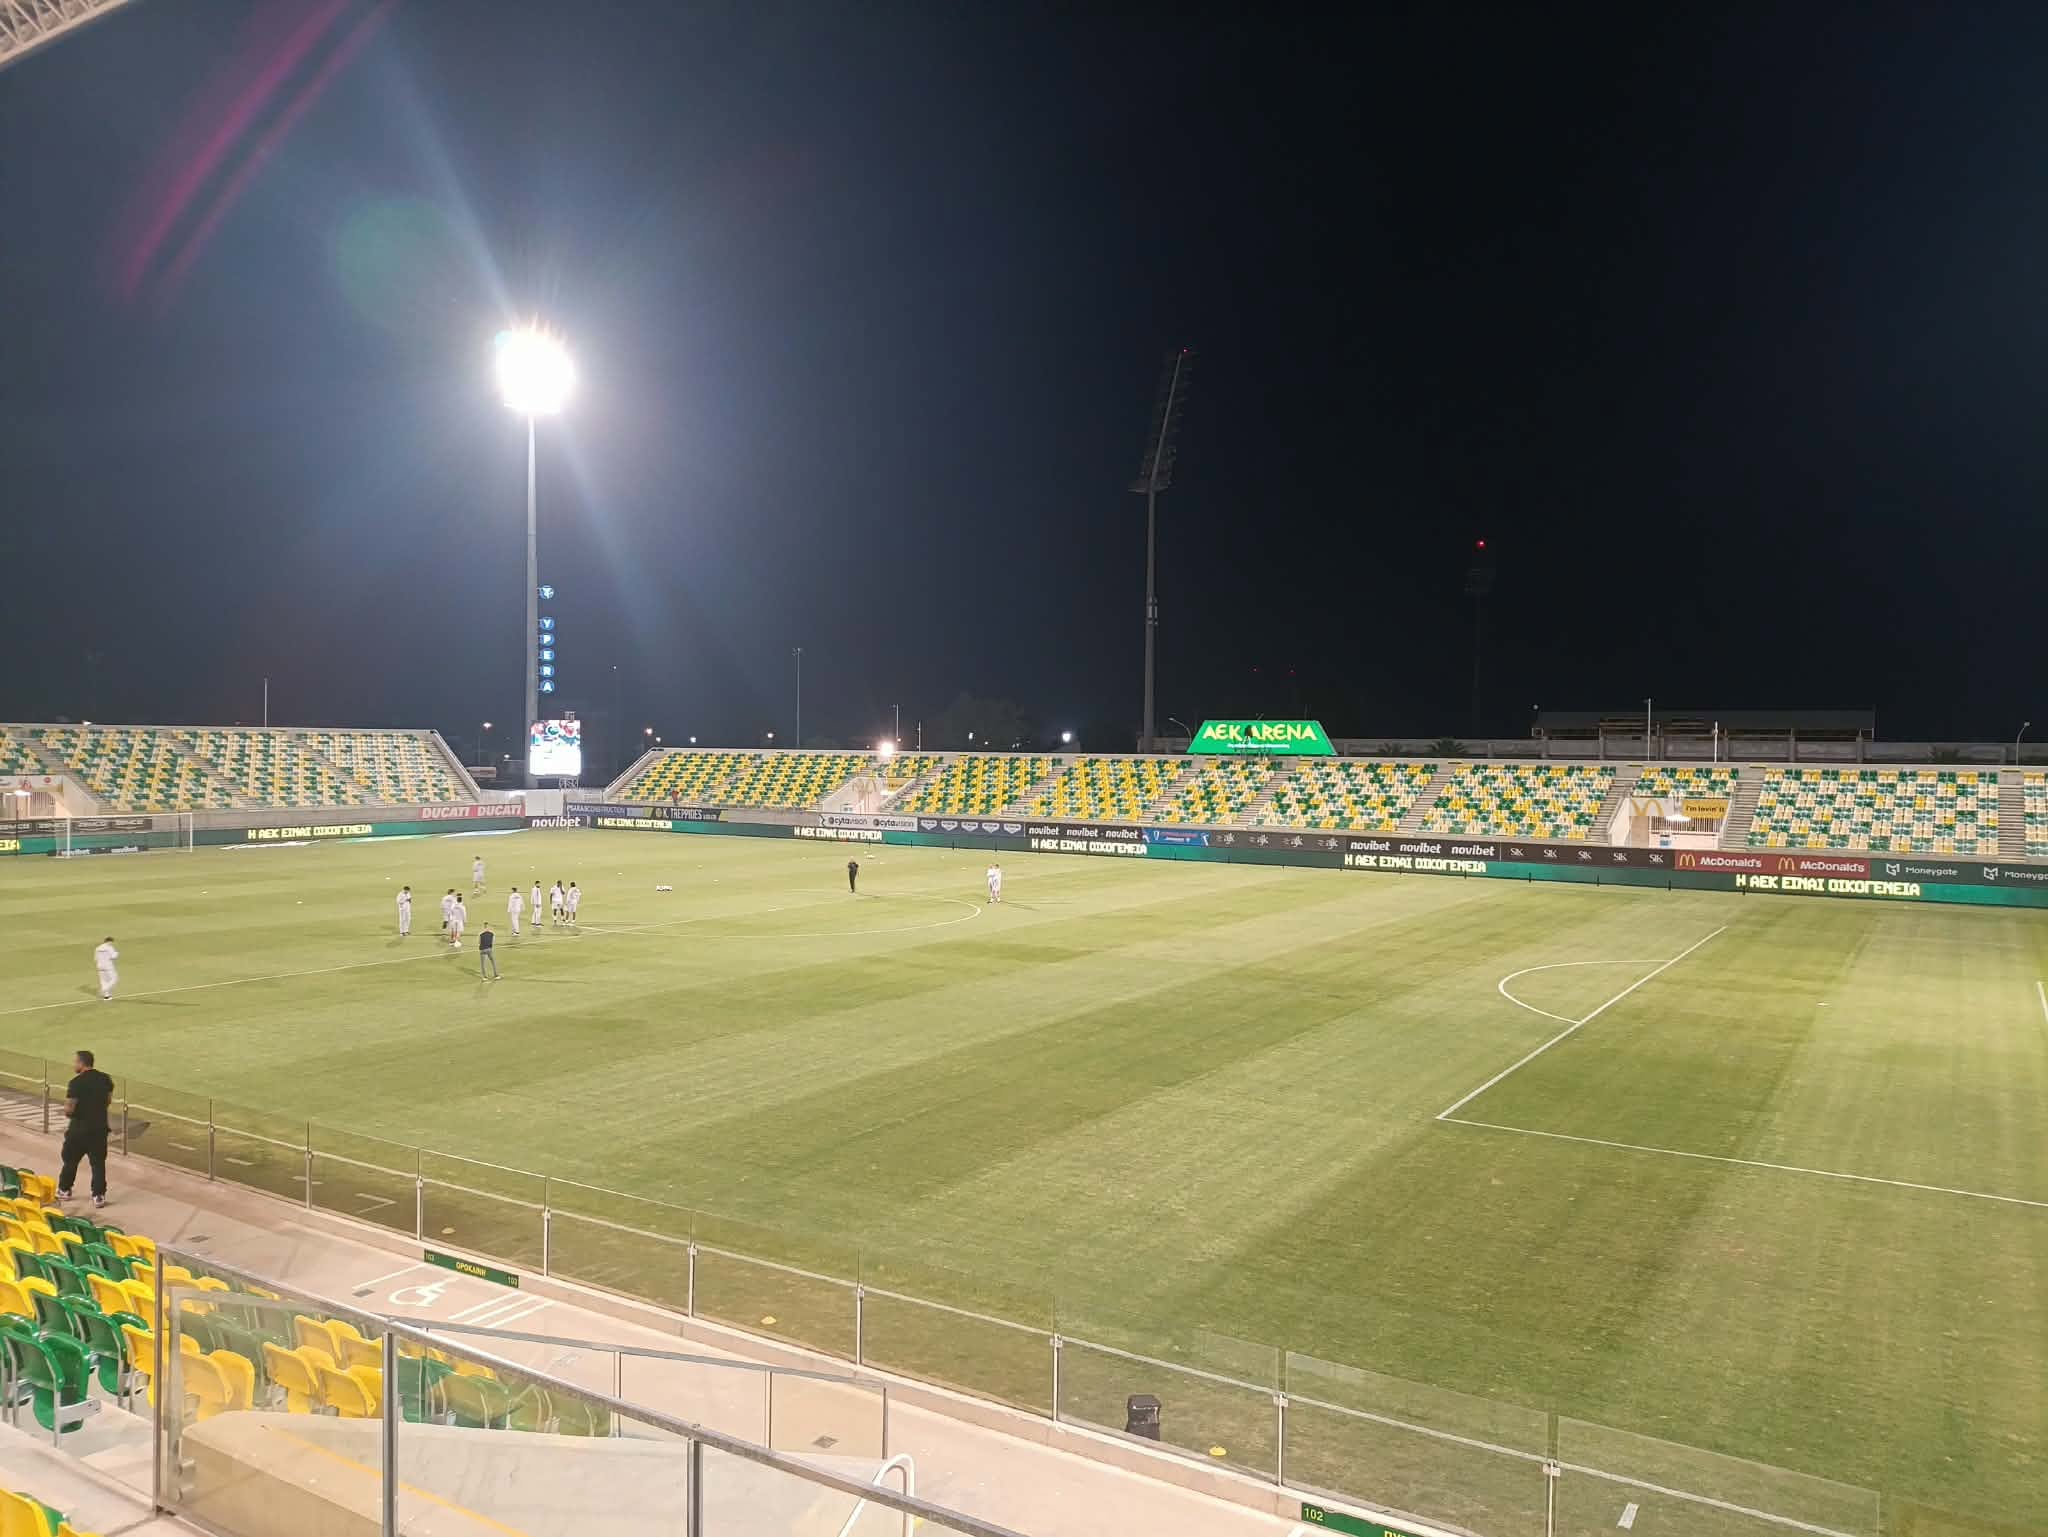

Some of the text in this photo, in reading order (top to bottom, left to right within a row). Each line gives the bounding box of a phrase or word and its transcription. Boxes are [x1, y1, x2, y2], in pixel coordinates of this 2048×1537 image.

[421, 807, 471, 819] DUCATI
[477, 805, 522, 816] DUCATI
[531, 816, 581, 828] novibet
[1028, 826, 1059, 836] novibet
[1066, 828, 1098, 838] novibet
[1105, 829, 1138, 840] novibet
[1350, 840, 1391, 851] novibet
[1400, 842, 1442, 854] novibet
[1451, 845, 1495, 857] novibet
[1700, 856, 1762, 868] McDonald's
[1800, 860, 1865, 873] McDonald's
[1304, 1508, 1324, 1521] 102
